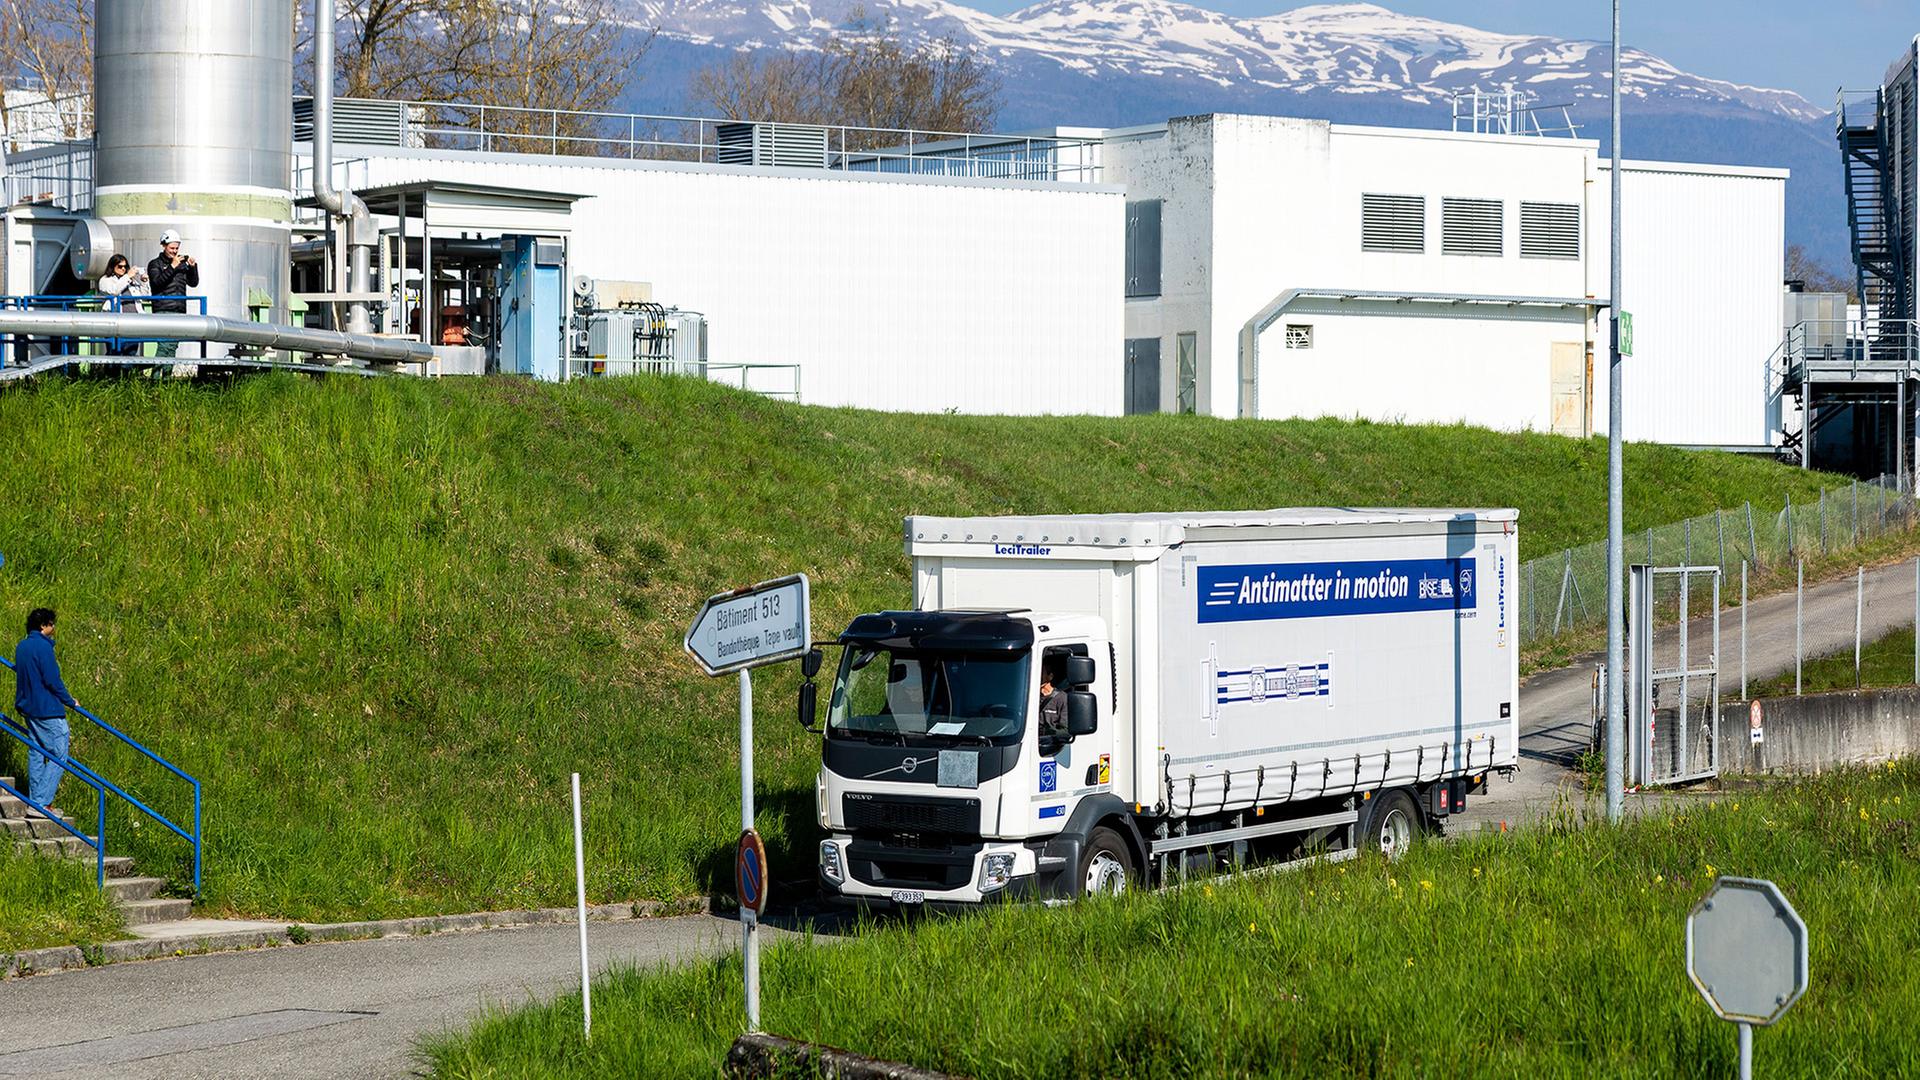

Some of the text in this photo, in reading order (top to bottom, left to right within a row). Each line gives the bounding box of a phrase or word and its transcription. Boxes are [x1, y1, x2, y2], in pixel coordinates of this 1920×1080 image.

[995, 544, 1051, 555] LeciTrailer
[1238, 567, 1409, 605] Antimatter in motion
[717, 594, 780, 631] Bâtiment 513
[717, 635, 760, 658] Bandothèque
[763, 629, 781, 649] Tape
[846, 793, 873, 801] VOLVO
